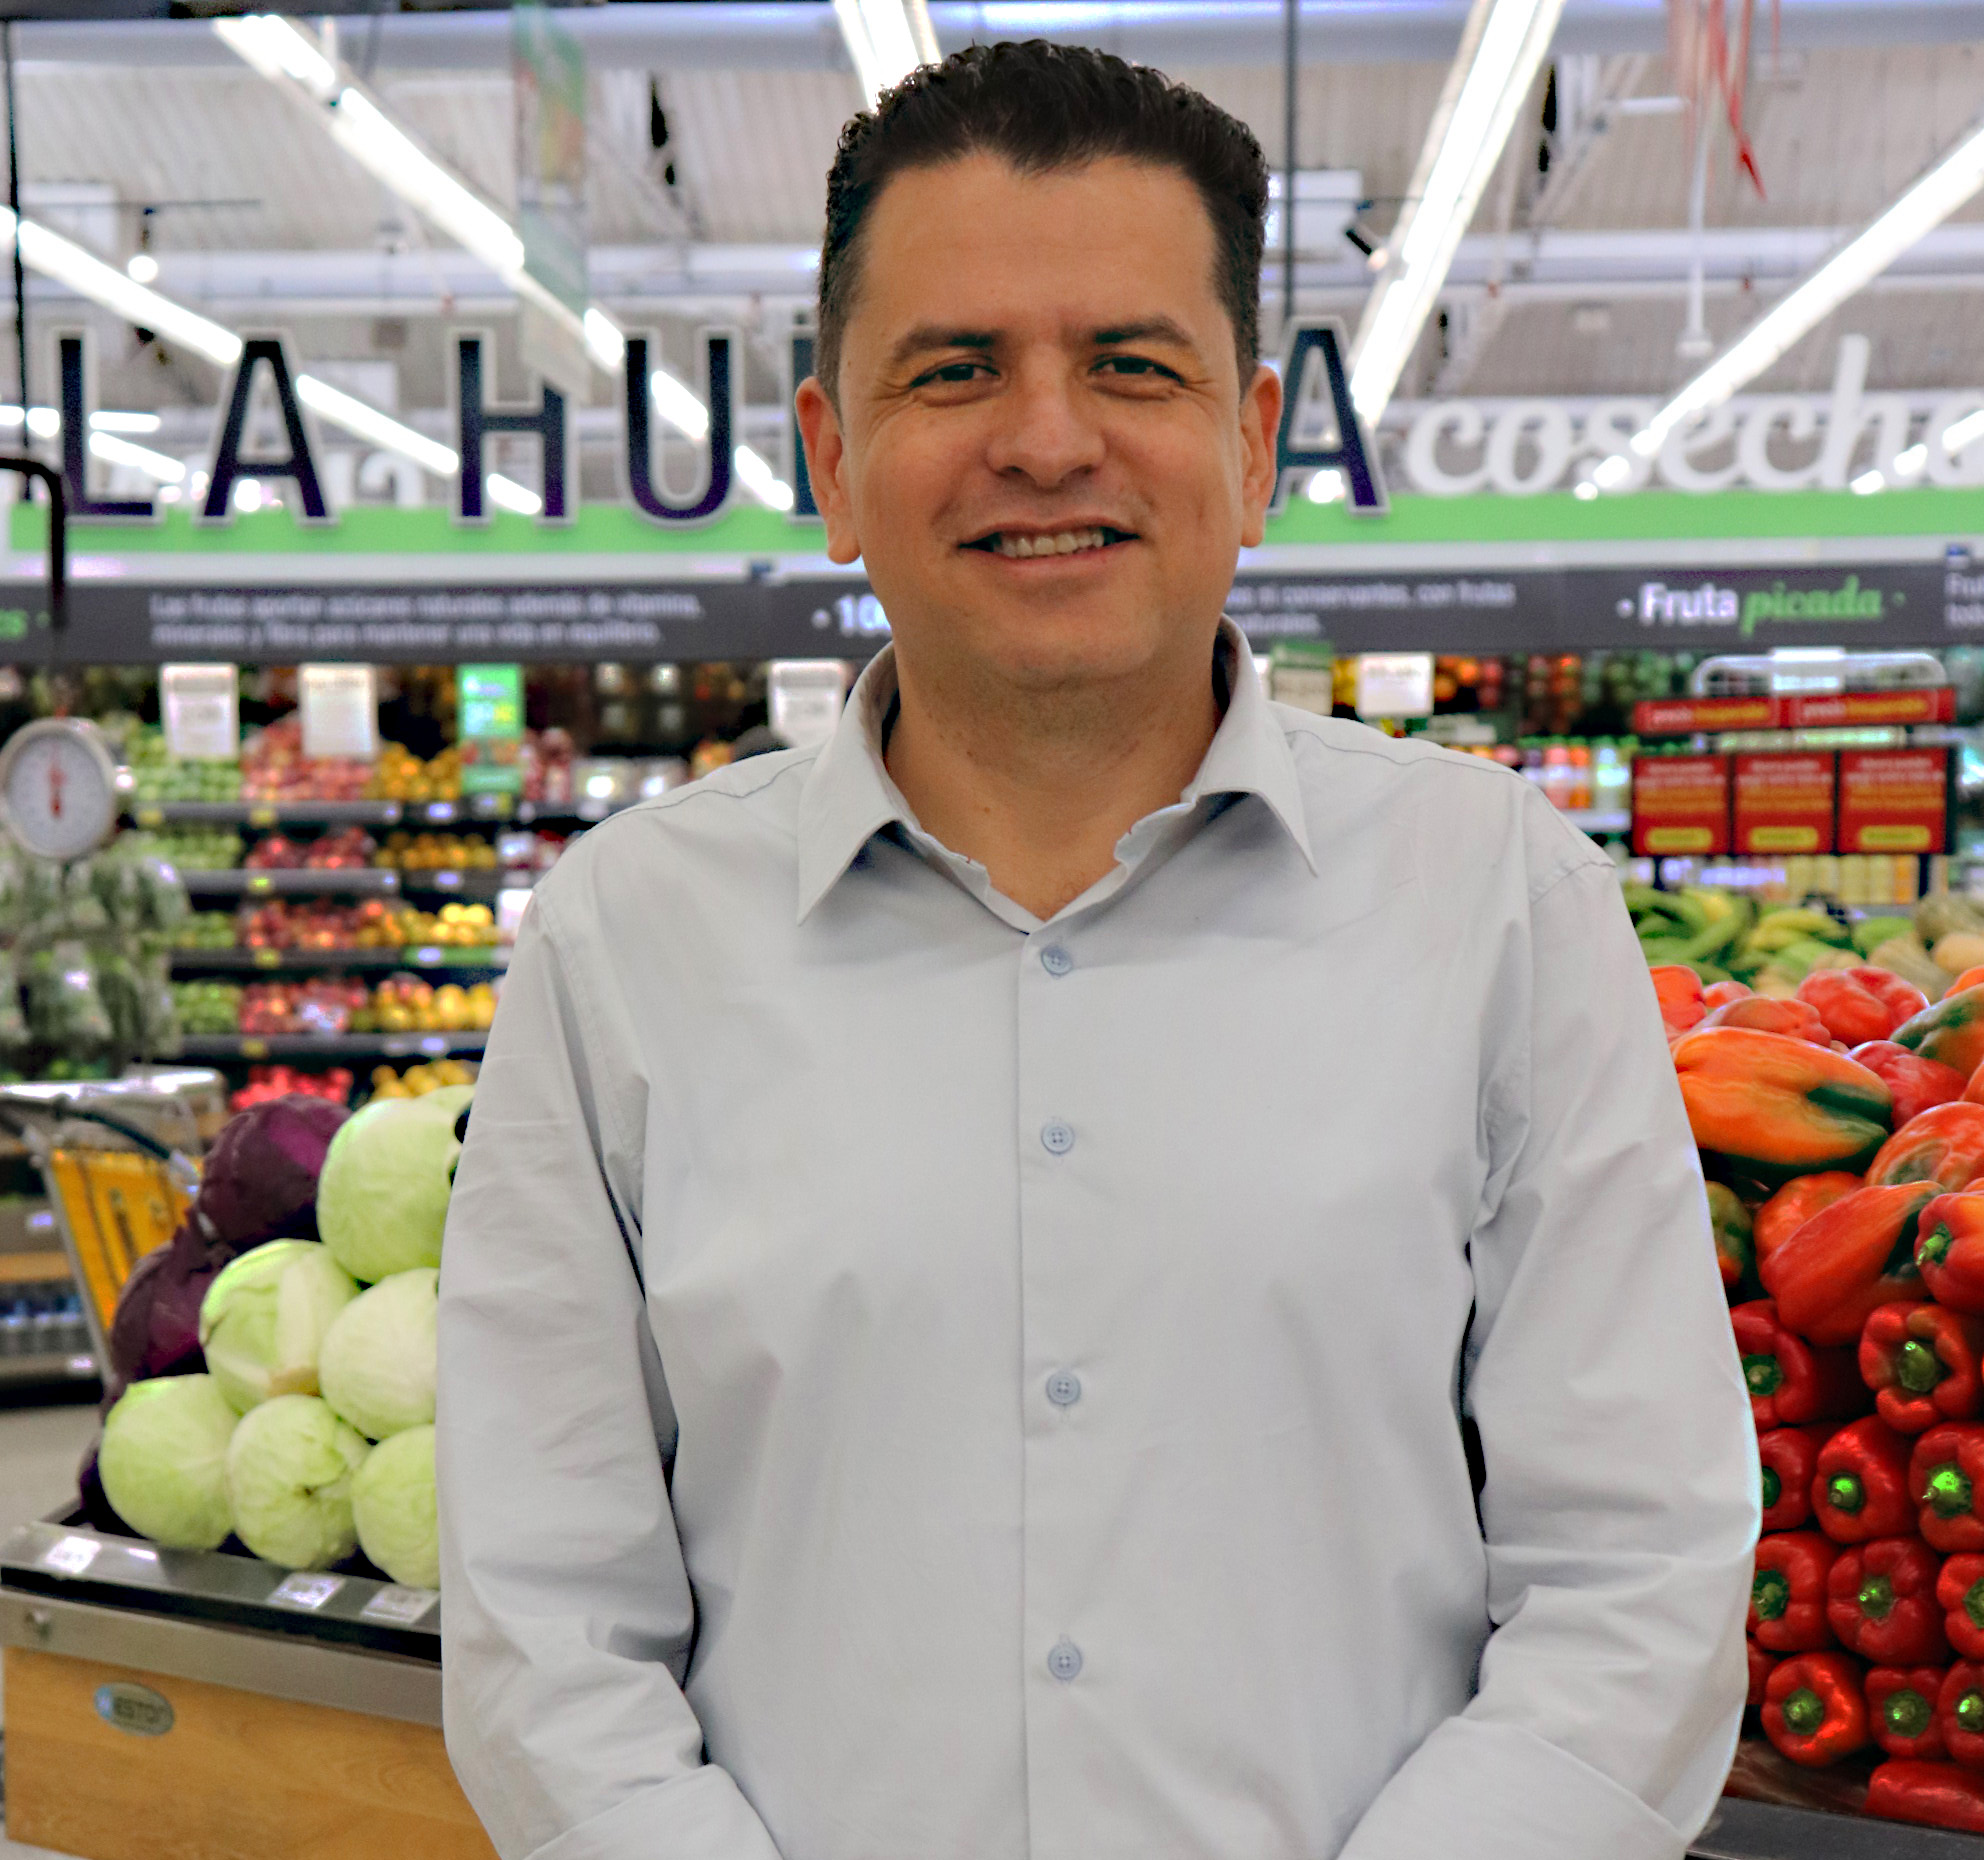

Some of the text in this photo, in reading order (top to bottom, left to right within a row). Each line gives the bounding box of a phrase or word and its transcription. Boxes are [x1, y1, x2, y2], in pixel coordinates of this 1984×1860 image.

[54, 331, 332, 523] LA
[1640, 575, 1884, 639] Fruta picada
